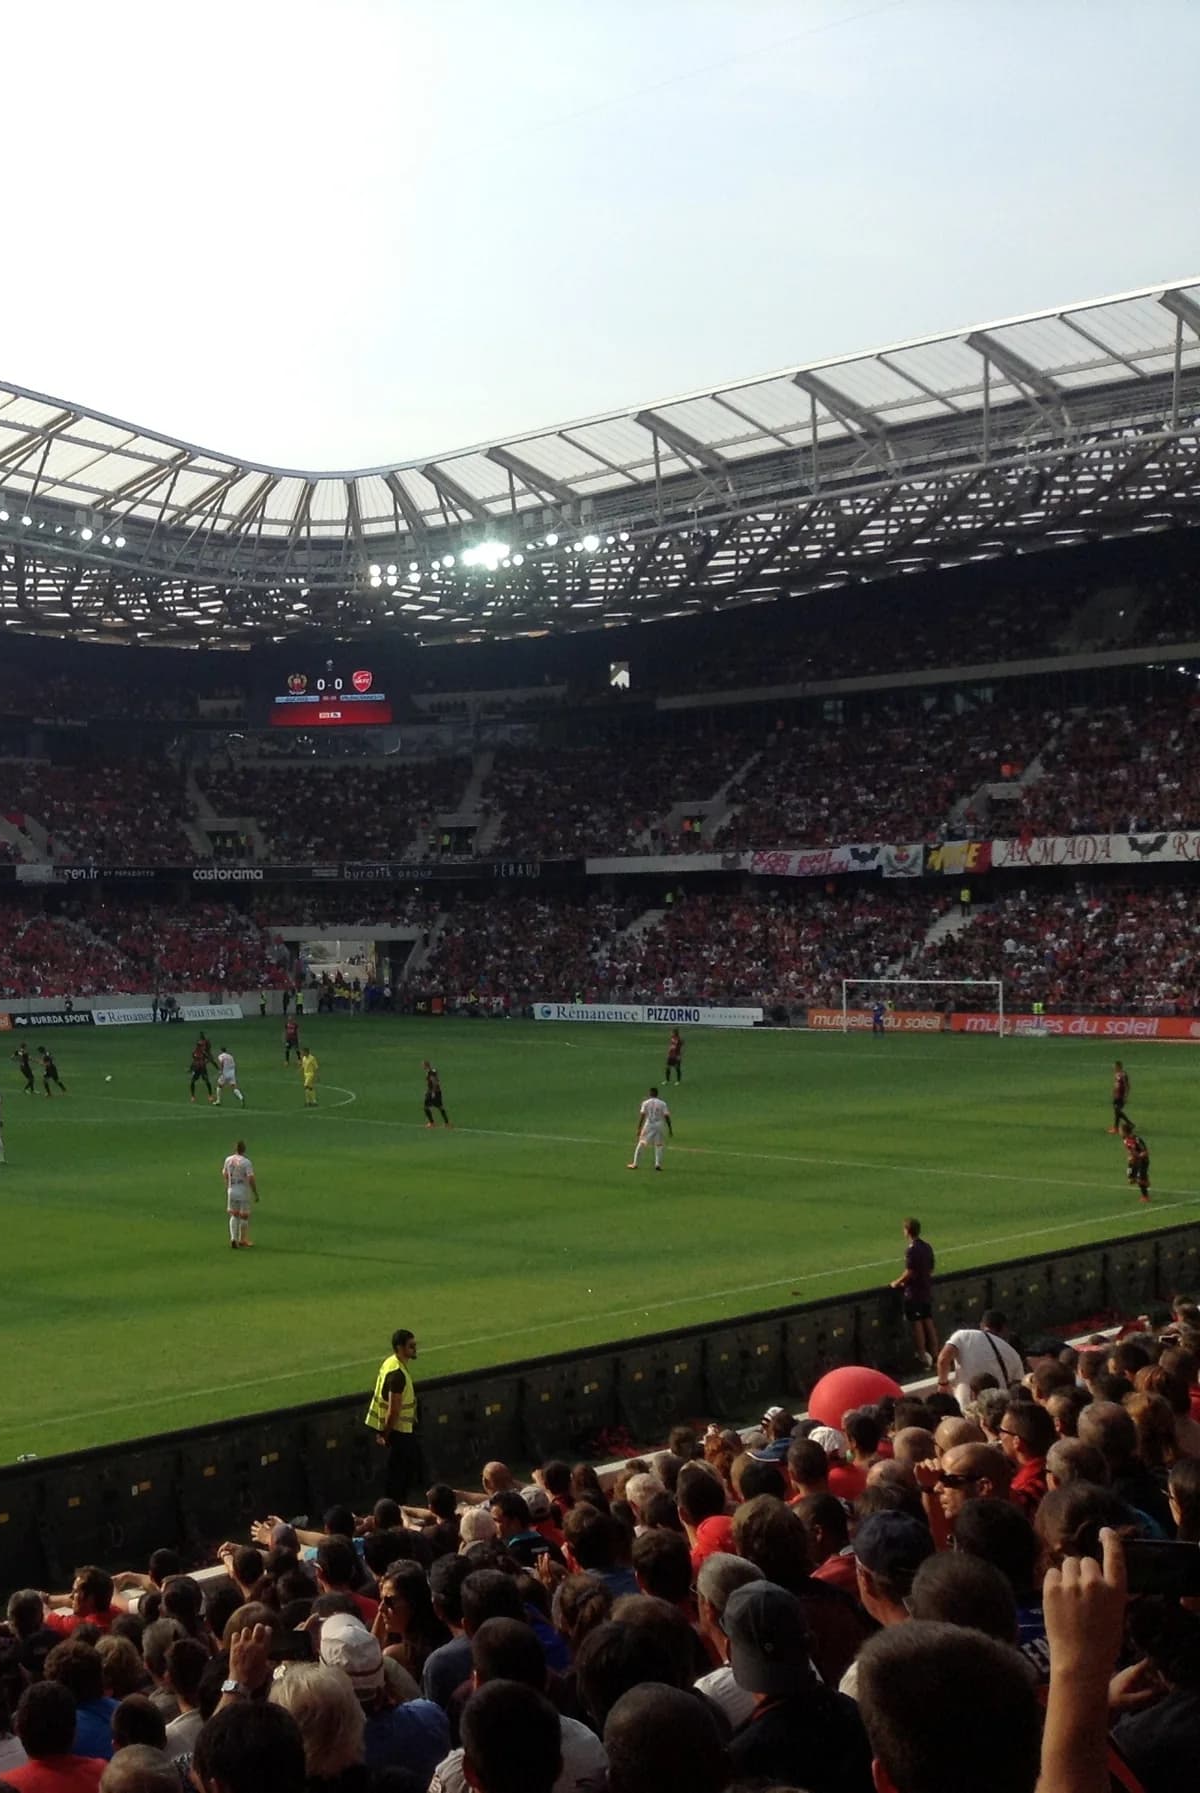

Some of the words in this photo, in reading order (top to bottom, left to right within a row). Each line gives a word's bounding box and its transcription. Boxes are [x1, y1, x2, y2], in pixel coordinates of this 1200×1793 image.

[316, 678, 325, 690] 0
[334, 678, 343, 690] 0
[193, 867, 264, 880] castorama
[31, 1015, 62, 1025] BURRDA
[65, 1014, 90, 1024] SPORT
[556, 1005, 639, 1021] Rémanence
[647, 1008, 700, 1022] PIZZORNO
[813, 1014, 873, 1027] mutuelle
[883, 1015, 903, 1028] du
[905, 1016, 941, 1030] soleil
[1067, 1015, 1098, 1034] du
[1104, 1017, 1160, 1036] soleil
